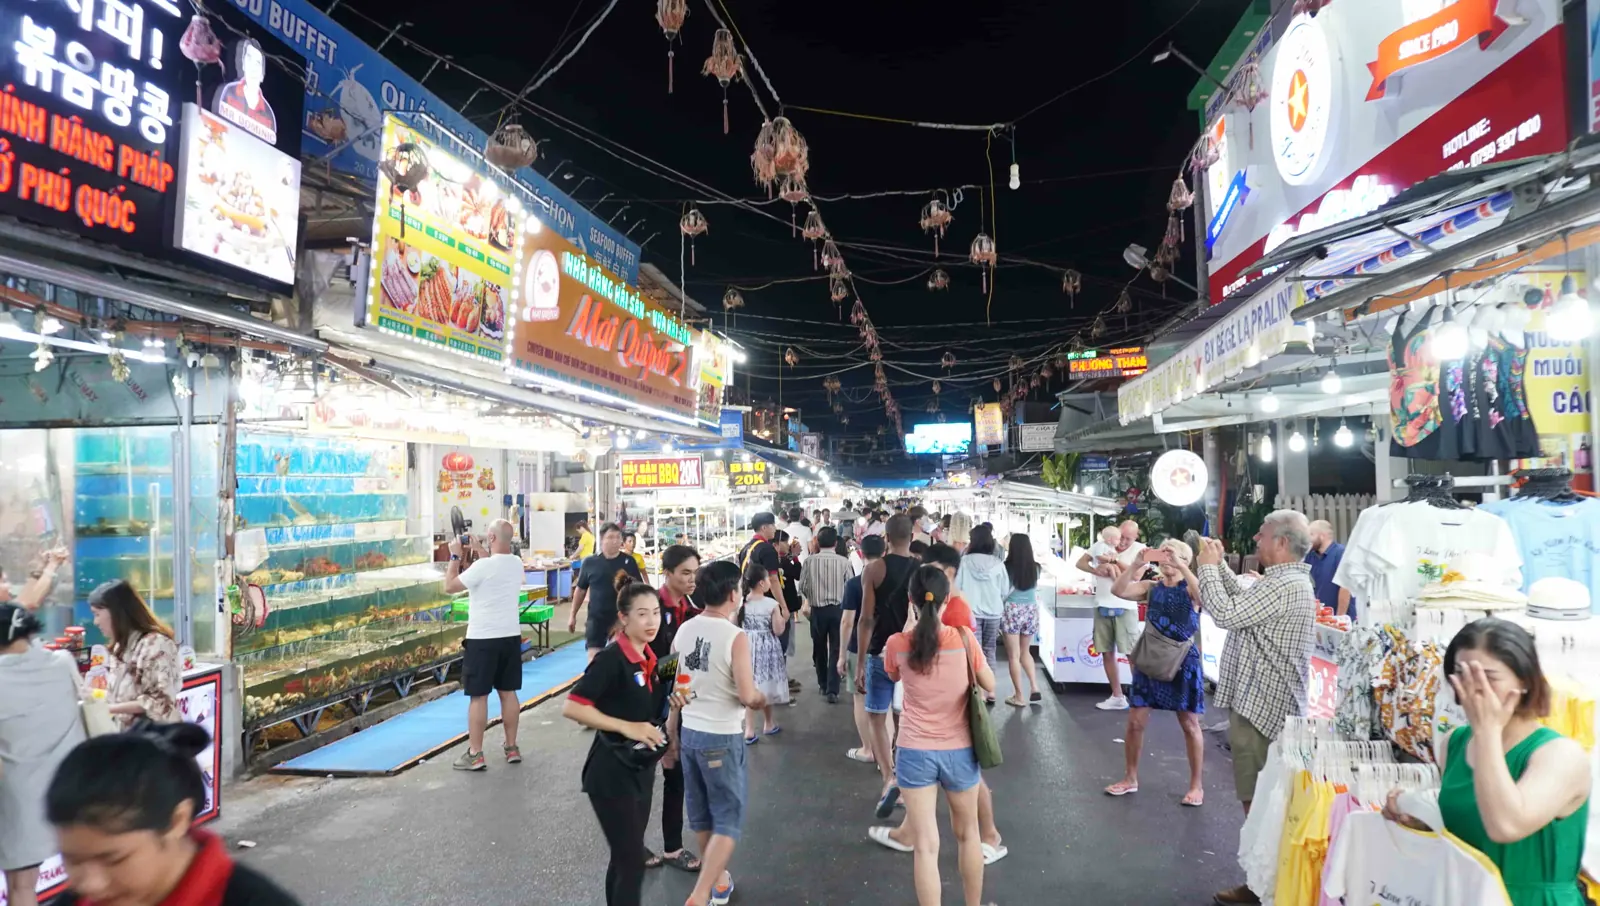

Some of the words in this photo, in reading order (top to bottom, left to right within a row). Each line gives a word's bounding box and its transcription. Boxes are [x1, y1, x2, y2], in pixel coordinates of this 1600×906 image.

[269, 0, 337, 65] BUFFET
[1399, 33, 1432, 60] SINCE
[14, 14, 173, 143] 볶음땅콩
[220, 104, 235, 121] MR
[238, 115, 276, 143] DOMINIC
[1442, 117, 1491, 159] HOTLINE:
[118, 143, 174, 193] PHÁP
[18, 166, 72, 213] PHÚ
[75, 184, 137, 234] QUỐC
[541, 195, 576, 232] CHỌN
[590, 227, 616, 255] SEAFOOD
[615, 243, 635, 267] BUFFET
[563, 251, 587, 285] NHÀ
[588, 265, 614, 302] HÀNG
[614, 282, 629, 311] HẢI
[628, 292, 645, 320] SẢN
[566, 294, 620, 352] Mai
[1204, 337, 1215, 364] BY
[1237, 314, 1251, 344] LA
[123, 376, 149, 402] UMAX
[658, 463, 679, 485] BBQ
[679, 459, 699, 486] 20K
[729, 461, 766, 473] BBQ
[734, 473, 765, 486] 20K
